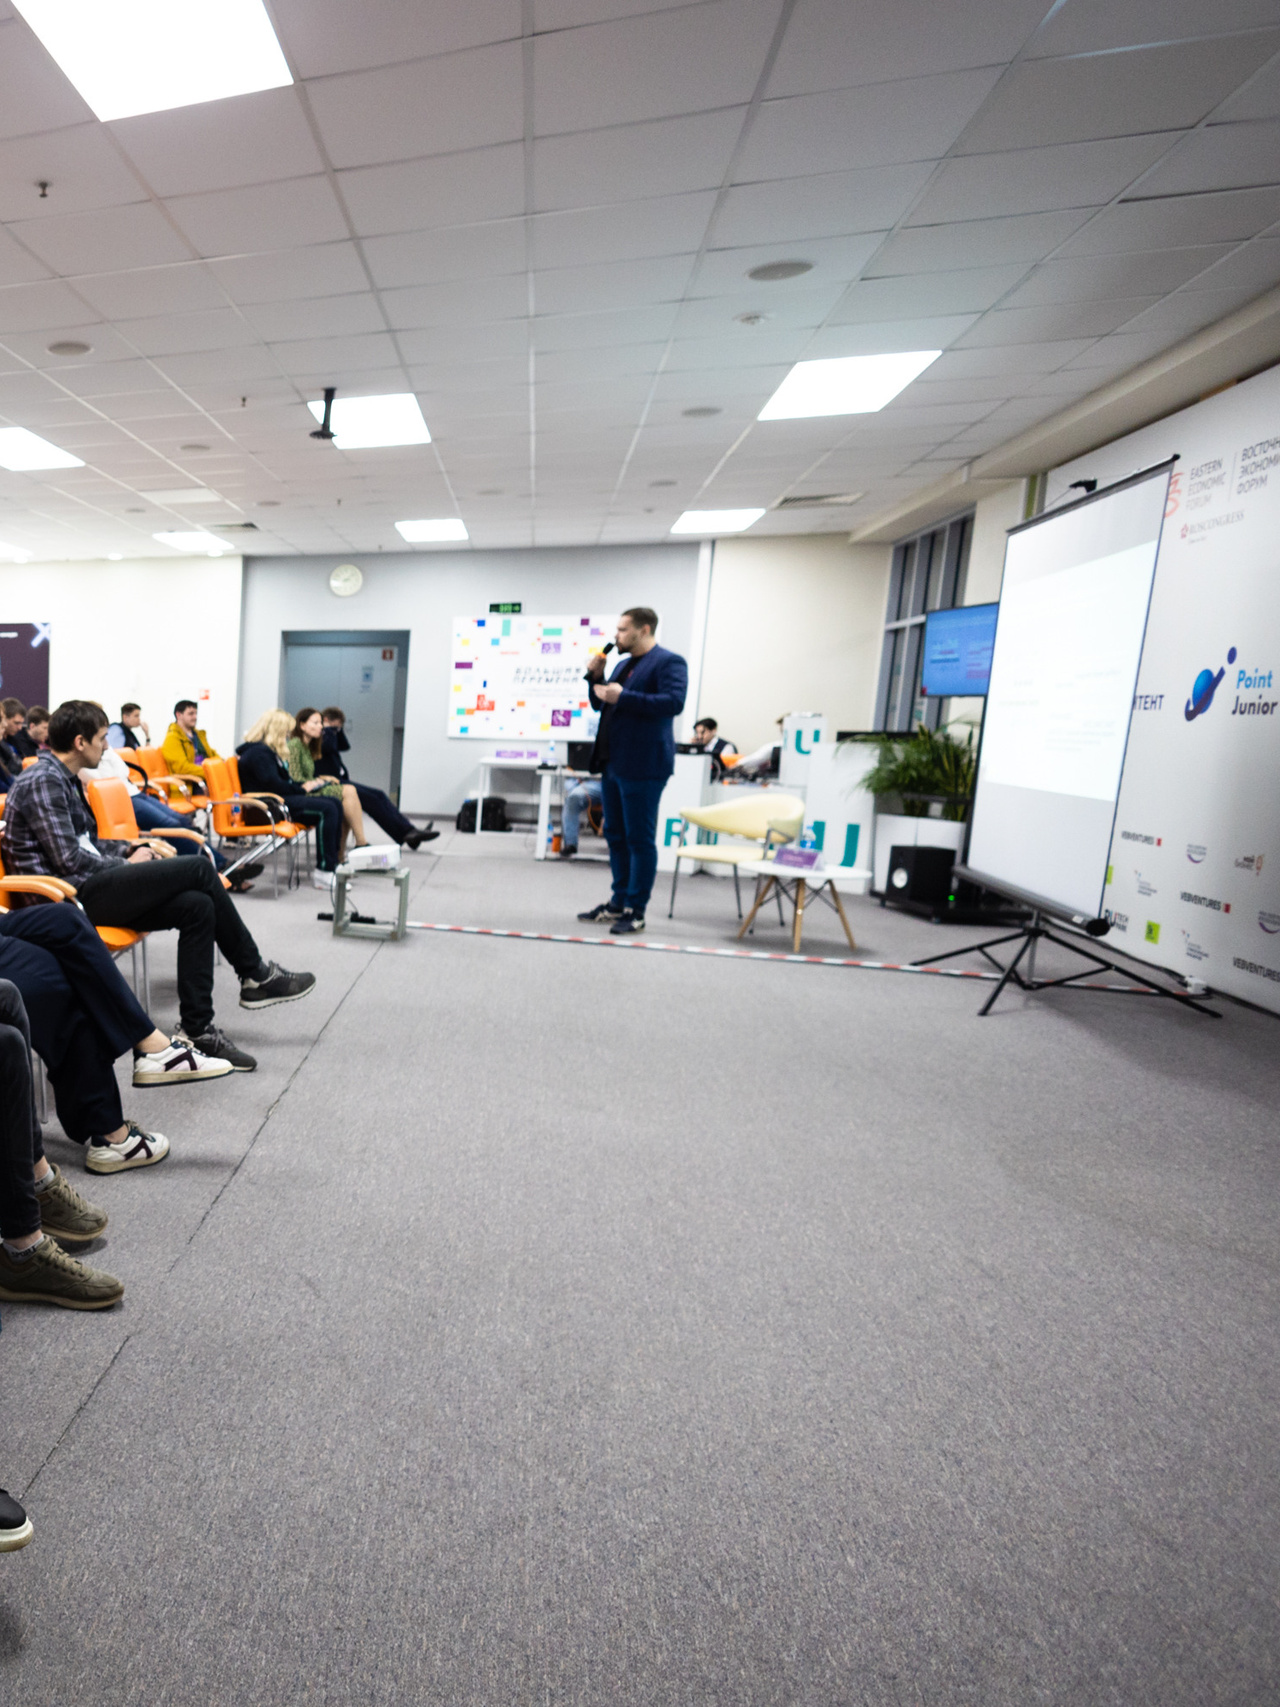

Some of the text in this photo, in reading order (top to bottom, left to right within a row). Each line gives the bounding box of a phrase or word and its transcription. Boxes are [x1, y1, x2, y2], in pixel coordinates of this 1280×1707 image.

[1190, 458, 1223, 480] EASTERN
[1237, 474, 1268, 494] ФОРУМ
[1236, 668, 1272, 689] Point
[1232, 694, 1278, 715] Junior
